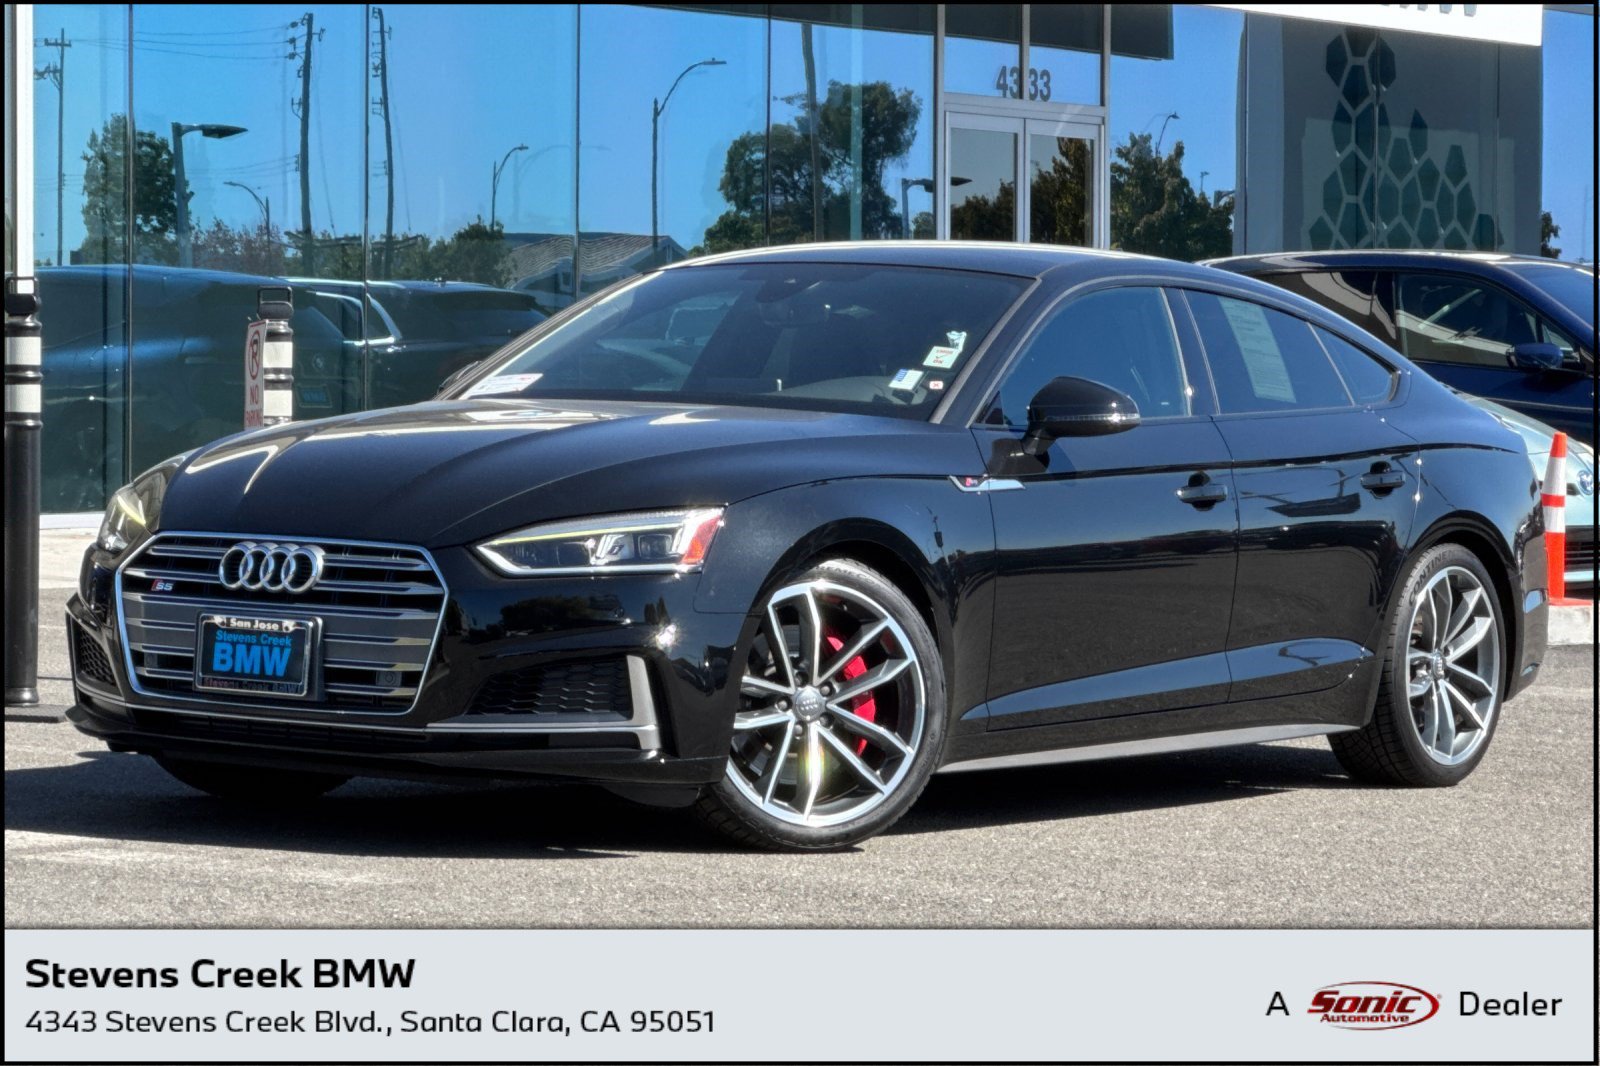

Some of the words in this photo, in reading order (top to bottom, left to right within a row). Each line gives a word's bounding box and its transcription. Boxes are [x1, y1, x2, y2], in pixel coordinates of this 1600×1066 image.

[996, 65, 1051, 102] 4333
[249, 384, 259, 405] NO
[155, 582, 174, 591] S5
[229, 617, 251, 629] San
[253, 619, 279, 631] Jose
[215, 630, 257, 643] Stevens
[260, 633, 292, 646] Creek
[212, 642, 291, 677] BMW
